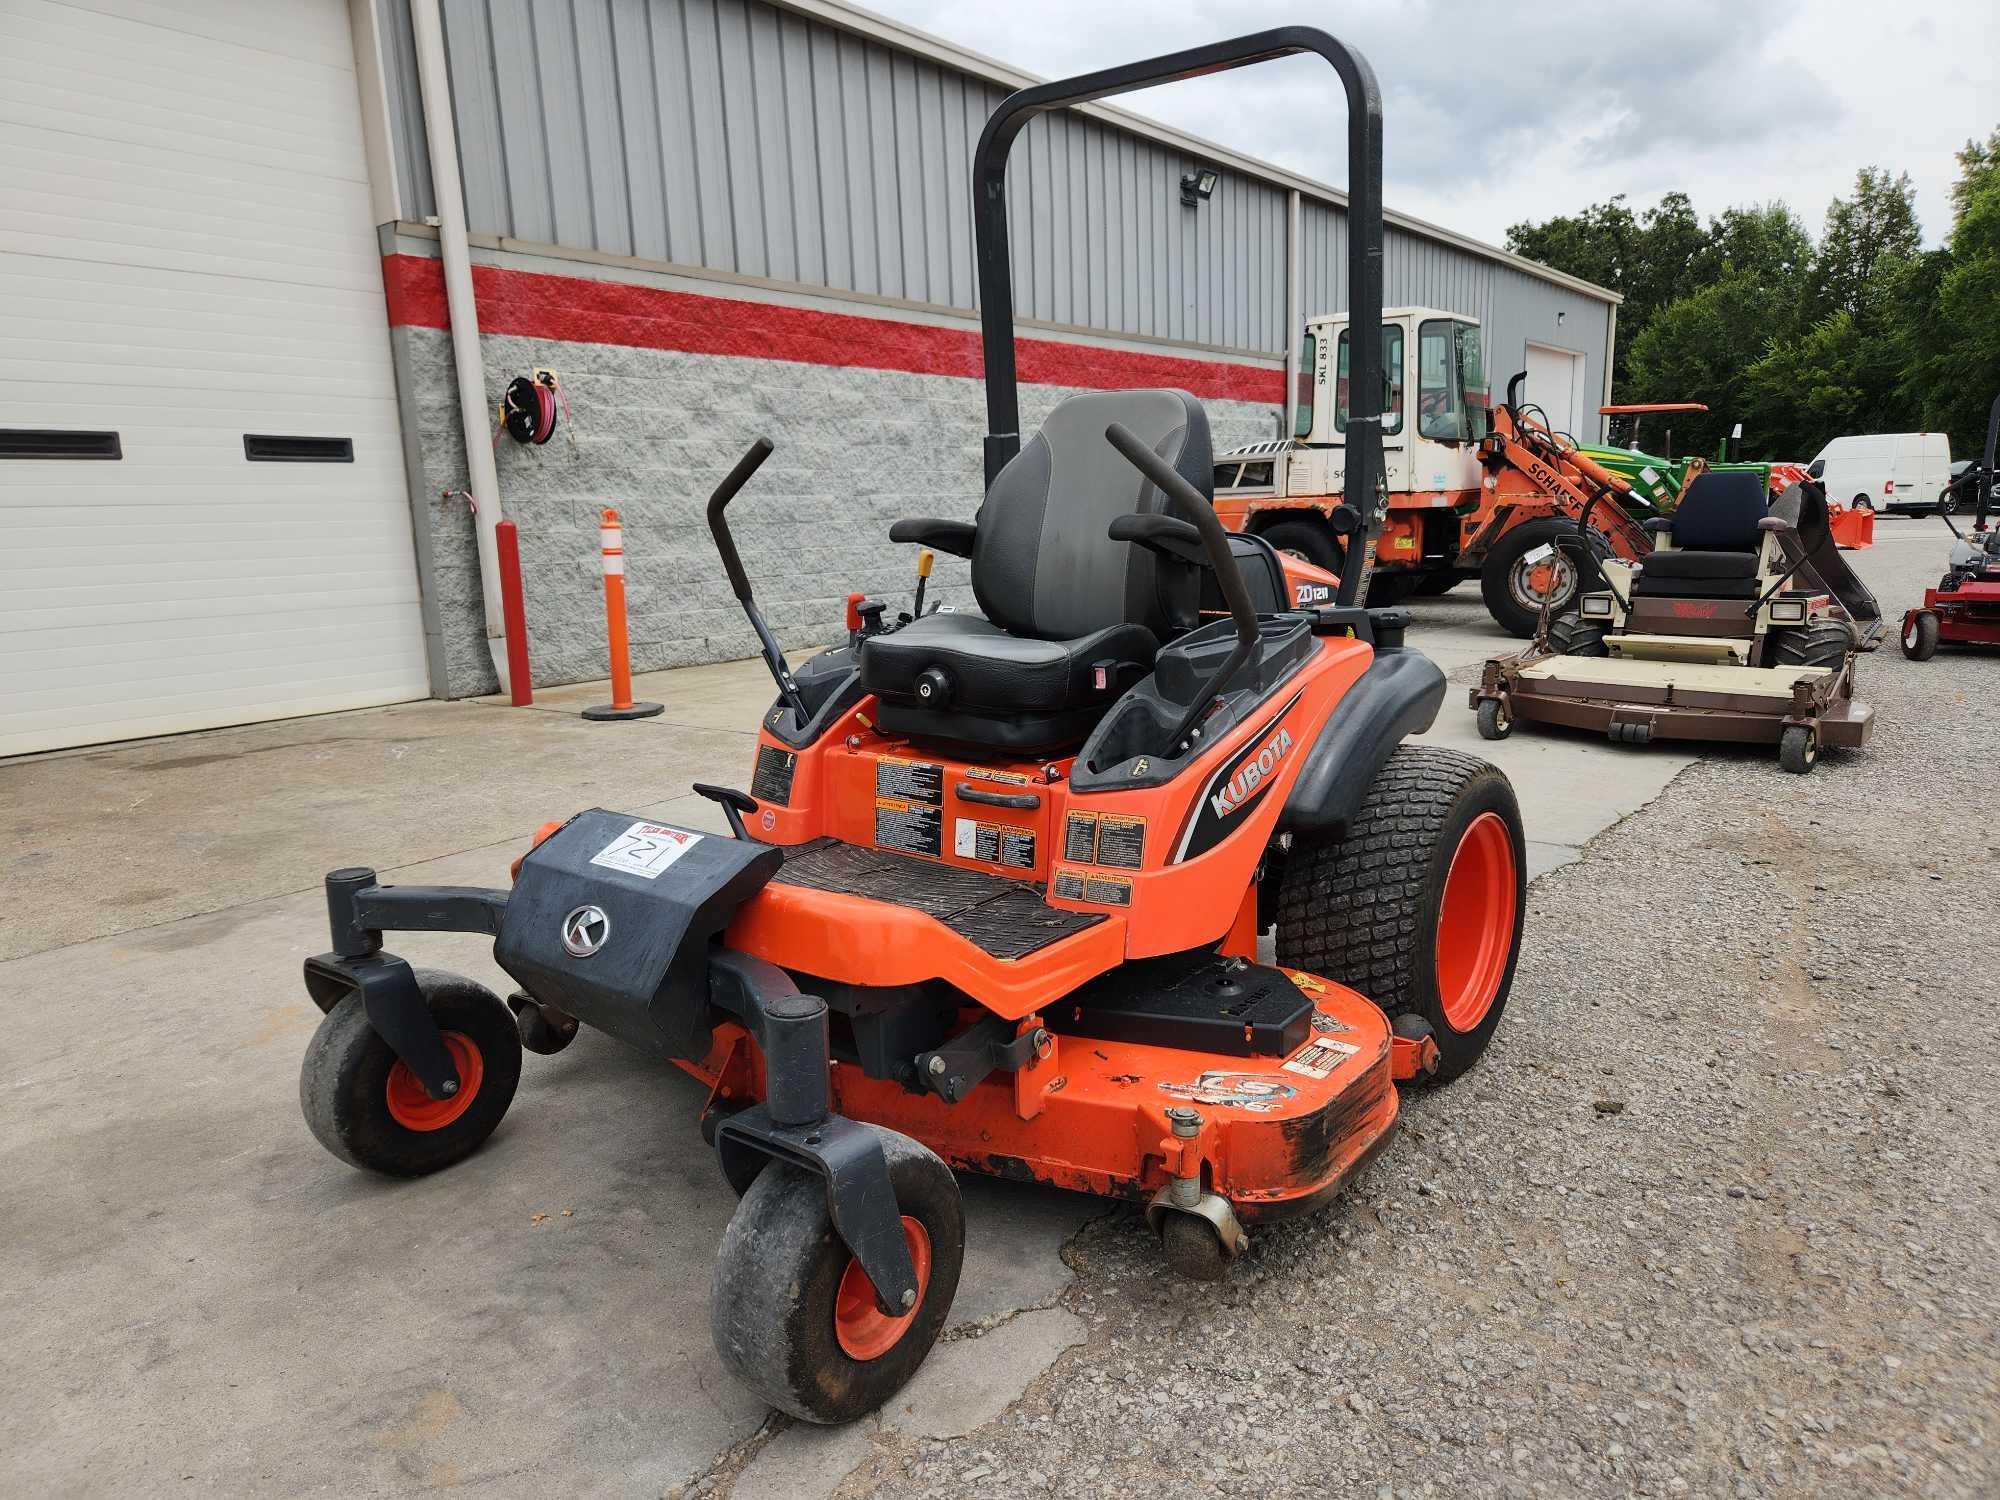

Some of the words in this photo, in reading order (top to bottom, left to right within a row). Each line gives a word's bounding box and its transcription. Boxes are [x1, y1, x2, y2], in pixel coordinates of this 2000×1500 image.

[1319, 338, 1328, 360] 833
[1318, 364, 1327, 385] SKL
[1210, 727, 1294, 820] KUBOTA
[607, 834, 671, 868] 721
